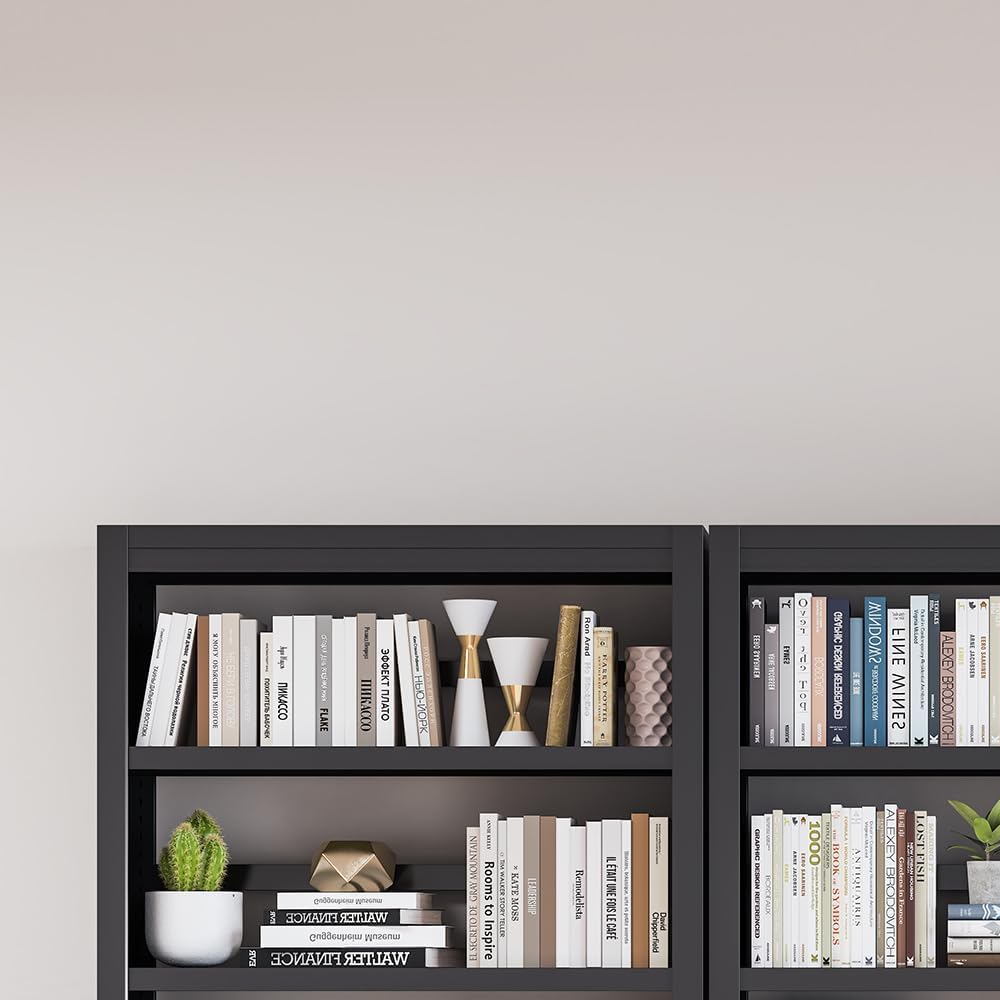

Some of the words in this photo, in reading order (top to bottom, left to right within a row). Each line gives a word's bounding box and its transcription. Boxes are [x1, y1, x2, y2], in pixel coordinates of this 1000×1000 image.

[381, 648, 390, 687] ЭФФЕКТ
[942, 634, 954, 675] ALEXEY
[277, 682, 288, 720] ПИКАССО
[319, 708, 329, 732] FLAKE
[360, 679, 372, 732] ПИКАССО
[381, 689, 390, 722] ПЛАТО
[414, 675, 429, 734] НЬЮ-ЙОРК
[942, 676, 954, 741] BRODOVITCH
[809, 821, 821, 866] 1000
[886, 808, 896, 863] ALEXEY
[484, 861, 495, 901] Rooms
[511, 872, 519, 896] KATE
[606, 864, 618, 883] ÉTAIT
[606, 883, 616, 897] UNE
[484, 903, 495, 917] to
[511, 898, 519, 922] MOSS
[527, 878, 537, 916] LEADERSHIP
[575, 869, 585, 920] Remodelista
[606, 897, 616, 913] FOIS
[886, 867, 896, 958] BRODOVITCH
[606, 914, 616, 922] LE
[606, 923, 618, 941] CAFÉ
[651, 911, 660, 953] Chipperfield
[659, 912, 667, 931] David
[482, 919, 495, 960] Inspire
